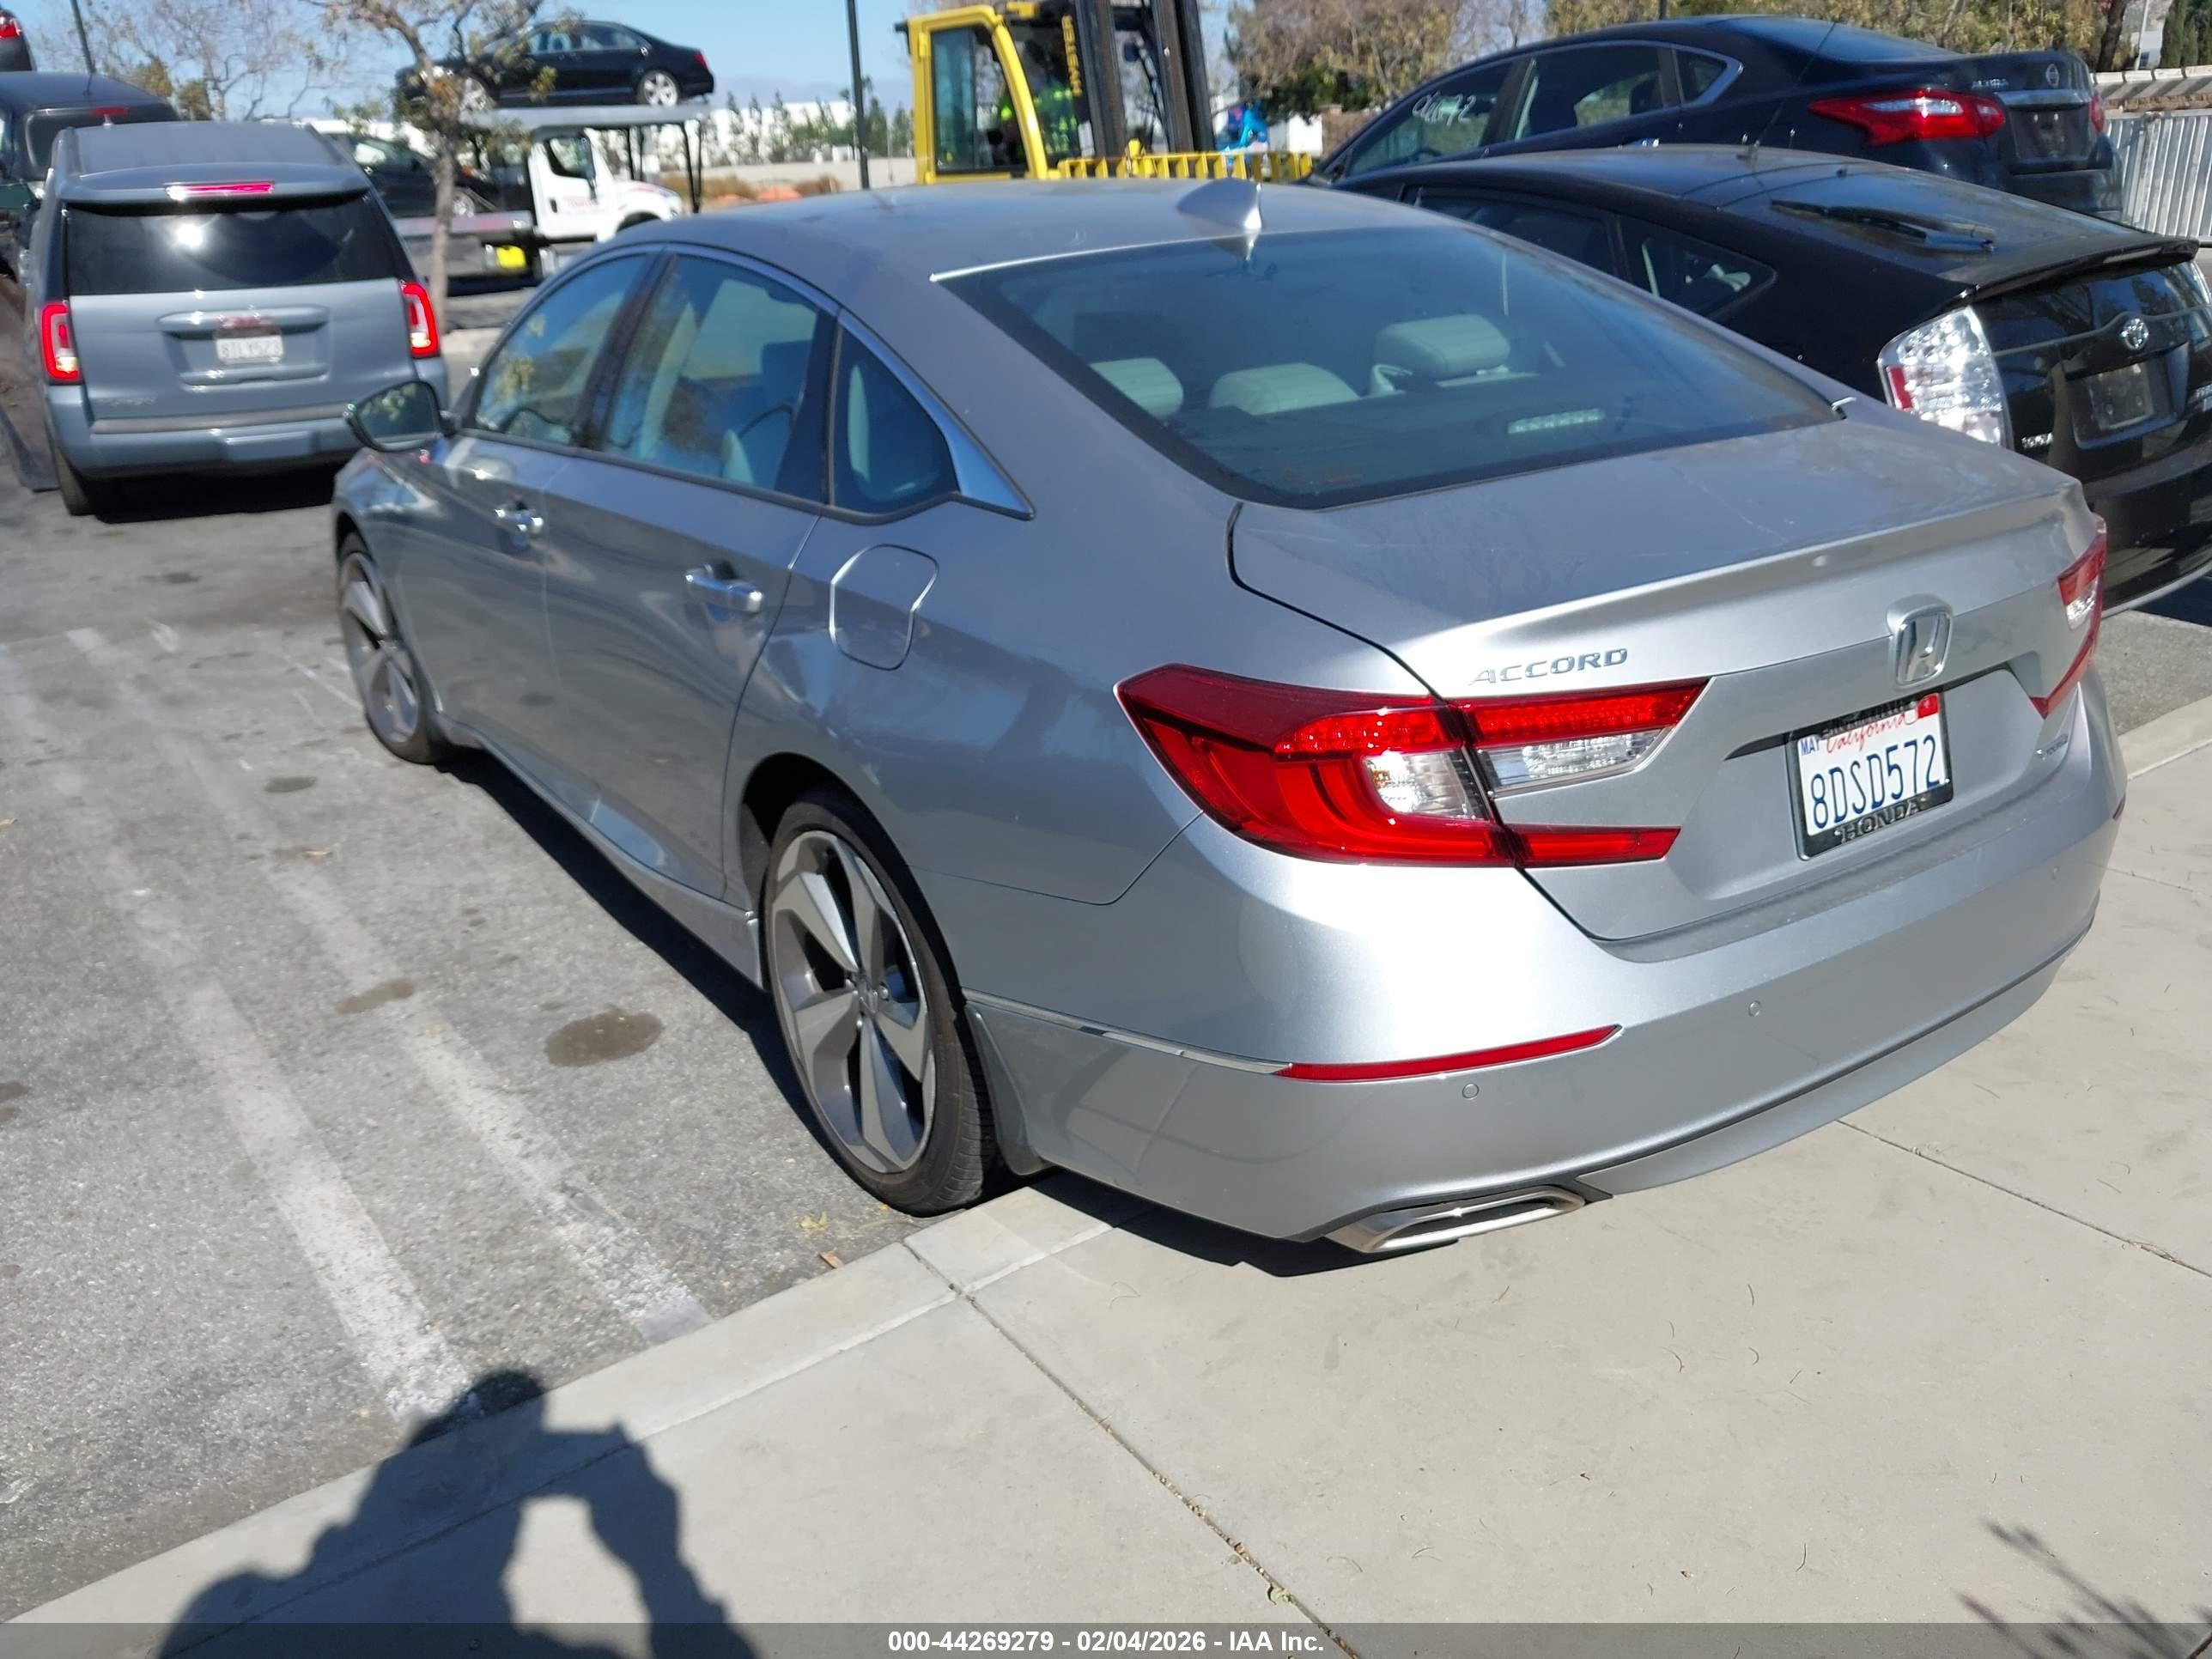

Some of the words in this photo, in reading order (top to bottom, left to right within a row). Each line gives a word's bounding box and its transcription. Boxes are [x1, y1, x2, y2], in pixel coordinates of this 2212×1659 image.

[1468, 647, 1628, 687] ACCORD
[1802, 735, 1820, 756] MAY
[1826, 712, 1907, 754] California
[1810, 734, 1940, 830] 8DSD572
[1840, 798, 1923, 844] HONDA
